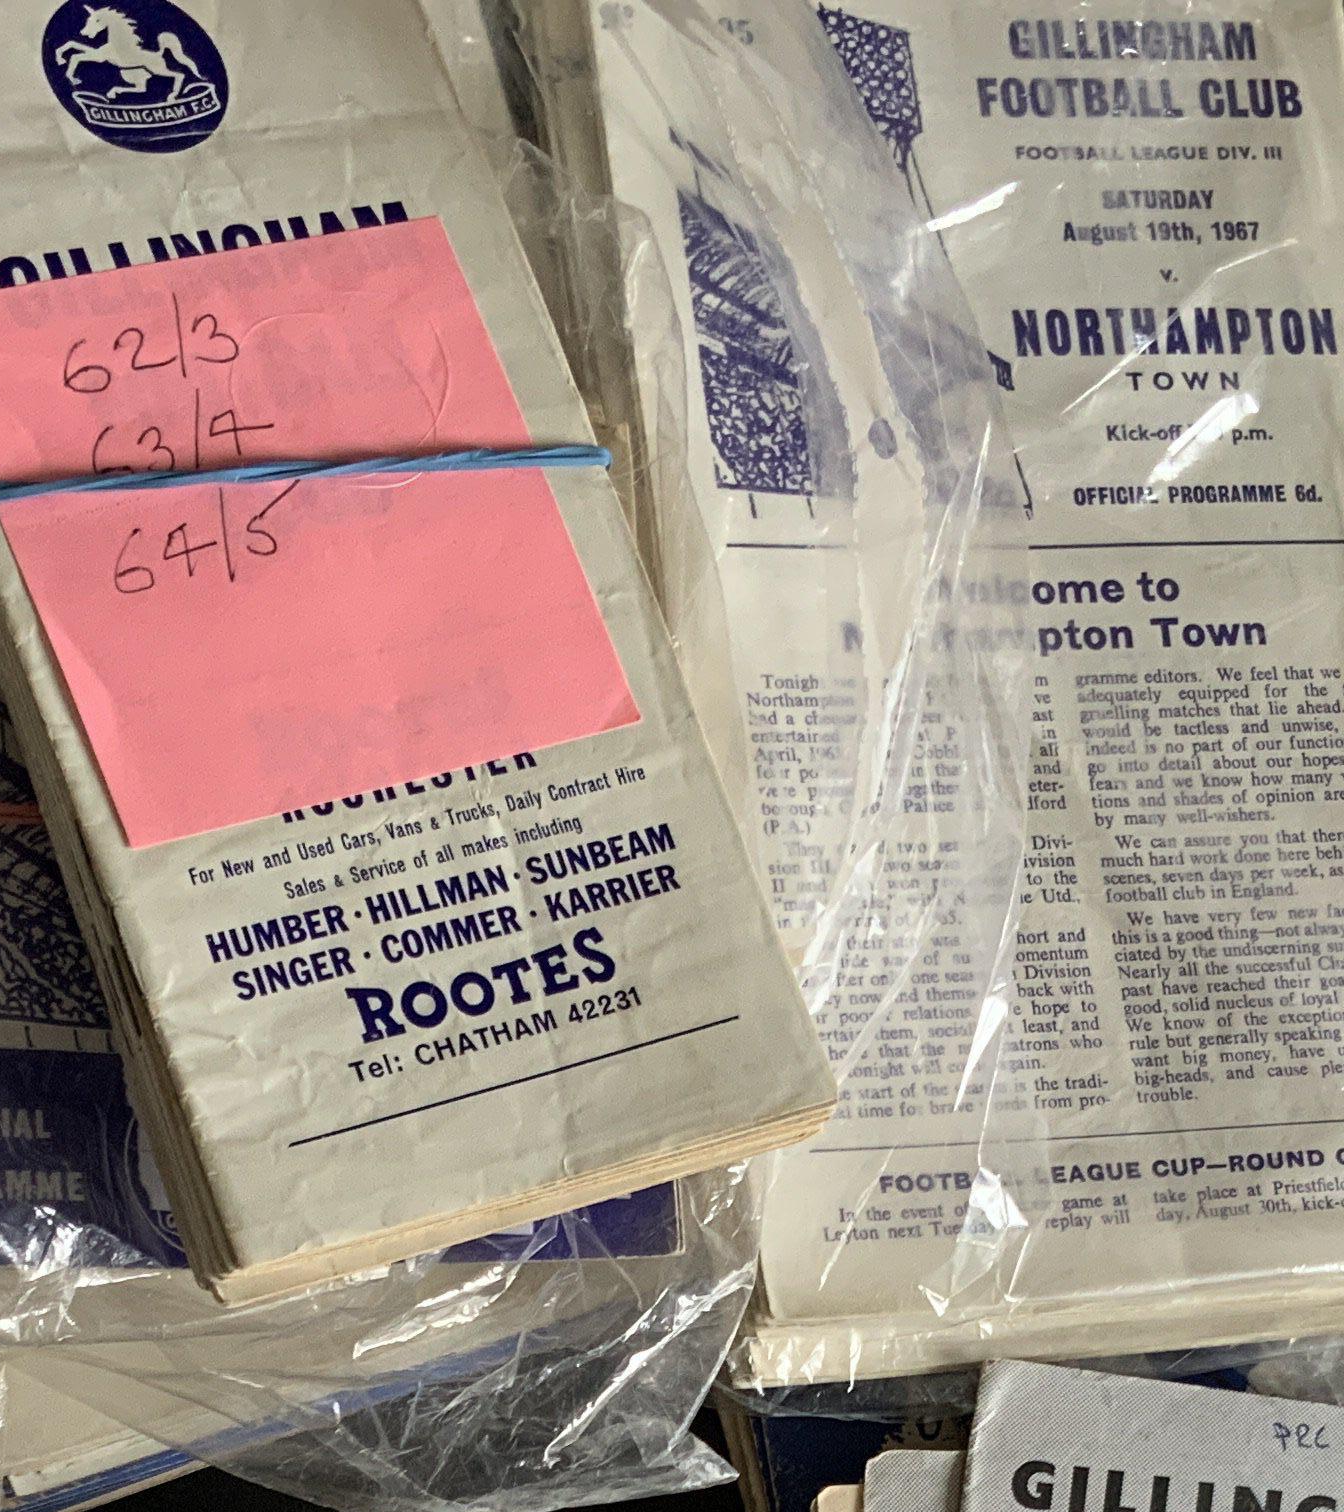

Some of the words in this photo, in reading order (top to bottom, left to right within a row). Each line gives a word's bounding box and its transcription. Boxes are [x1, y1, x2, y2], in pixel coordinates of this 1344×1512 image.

[1008, 20, 1257, 62] GILLINGHAM
[90, 105, 187, 122] GILLINGHAM
[977, 77, 1181, 119] FOOTBALL
[1201, 78, 1303, 119] CLUB
[1015, 146, 1123, 161] FOOTBALL
[1131, 146, 1208, 161] LEAGUE
[1216, 146, 1257, 161] DIV.
[1264, 146, 1283, 161] III
[1102, 190, 1213, 211] SATURDAY
[1063, 220, 1136, 245] August
[1148, 220, 1203, 244] 19th,
[1211, 222, 1259, 242] 1967
[63, 291, 239, 394] 62/3
[1012, 308, 1338, 358] NORTHAMPTON
[1126, 371, 1240, 391] TOWN
[1106, 424, 1182, 444] Kick-off
[1073, 486, 1157, 506] OFFICIAL
[1168, 485, 1287, 505] PROGRAMME
[1295, 485, 1323, 503] 6d.
[113, 479, 301, 594] 64/5
[1140, 571, 1180, 603] to
[1151, 617, 1267, 648] Town
[188, 865, 215, 886] For
[222, 856, 256, 880] New
[263, 847, 292, 869] and
[297, 838, 336, 863] Used
[341, 828, 383, 855] Cars,
[385, 819, 423, 842] Vans
[445, 801, 501, 827] Trucks,
[505, 791, 543, 815] Daily
[548, 773, 611, 802] Contract
[614, 765, 647, 788] Hire
[283, 875, 326, 901] Sales
[351, 856, 407, 884] Service
[435, 844, 455, 863] all
[462, 833, 509, 858] makes
[514, 814, 583, 846] including
[206, 904, 351, 964] HUMBER
[364, 865, 511, 926] HILLMAN
[525, 823, 677, 886] SUNBEAM
[1106, 887, 1168, 902] football
[1173, 887, 1206, 900] club
[1210, 887, 1226, 899] in
[1232, 884, 1298, 900] England.
[232, 945, 356, 1001] SINGER
[380, 906, 522, 964] COMMER
[544, 864, 682, 923] KARRIER
[345, 927, 618, 1044] ROOTES
[348, 1053, 405, 1085] Tel:
[414, 1009, 558, 1068] CHATHAM
[567, 986, 643, 1026] 42231
